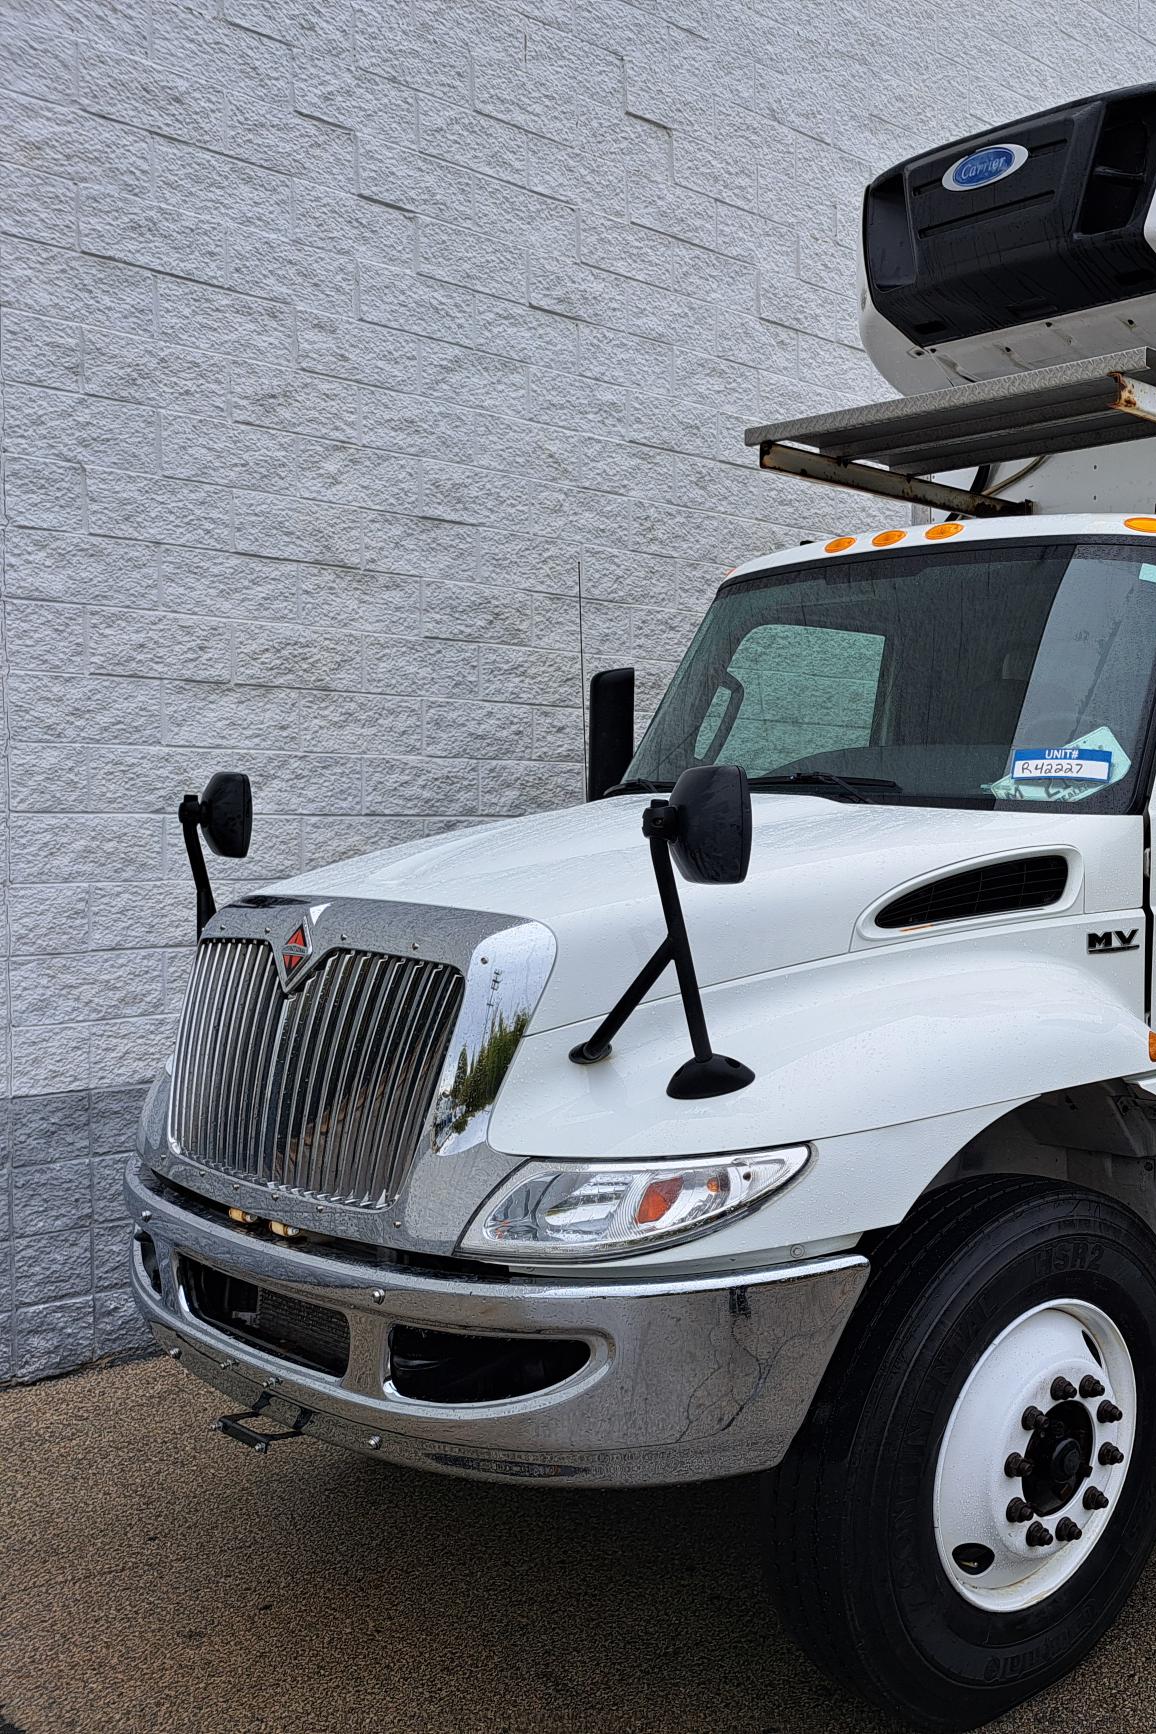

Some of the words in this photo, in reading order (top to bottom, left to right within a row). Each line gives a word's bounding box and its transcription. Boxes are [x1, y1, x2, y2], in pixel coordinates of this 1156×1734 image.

[961, 156, 1006, 179] Carrier
[1045, 749, 1079, 760] UNIT#
[1087, 929, 1139, 949] MV
